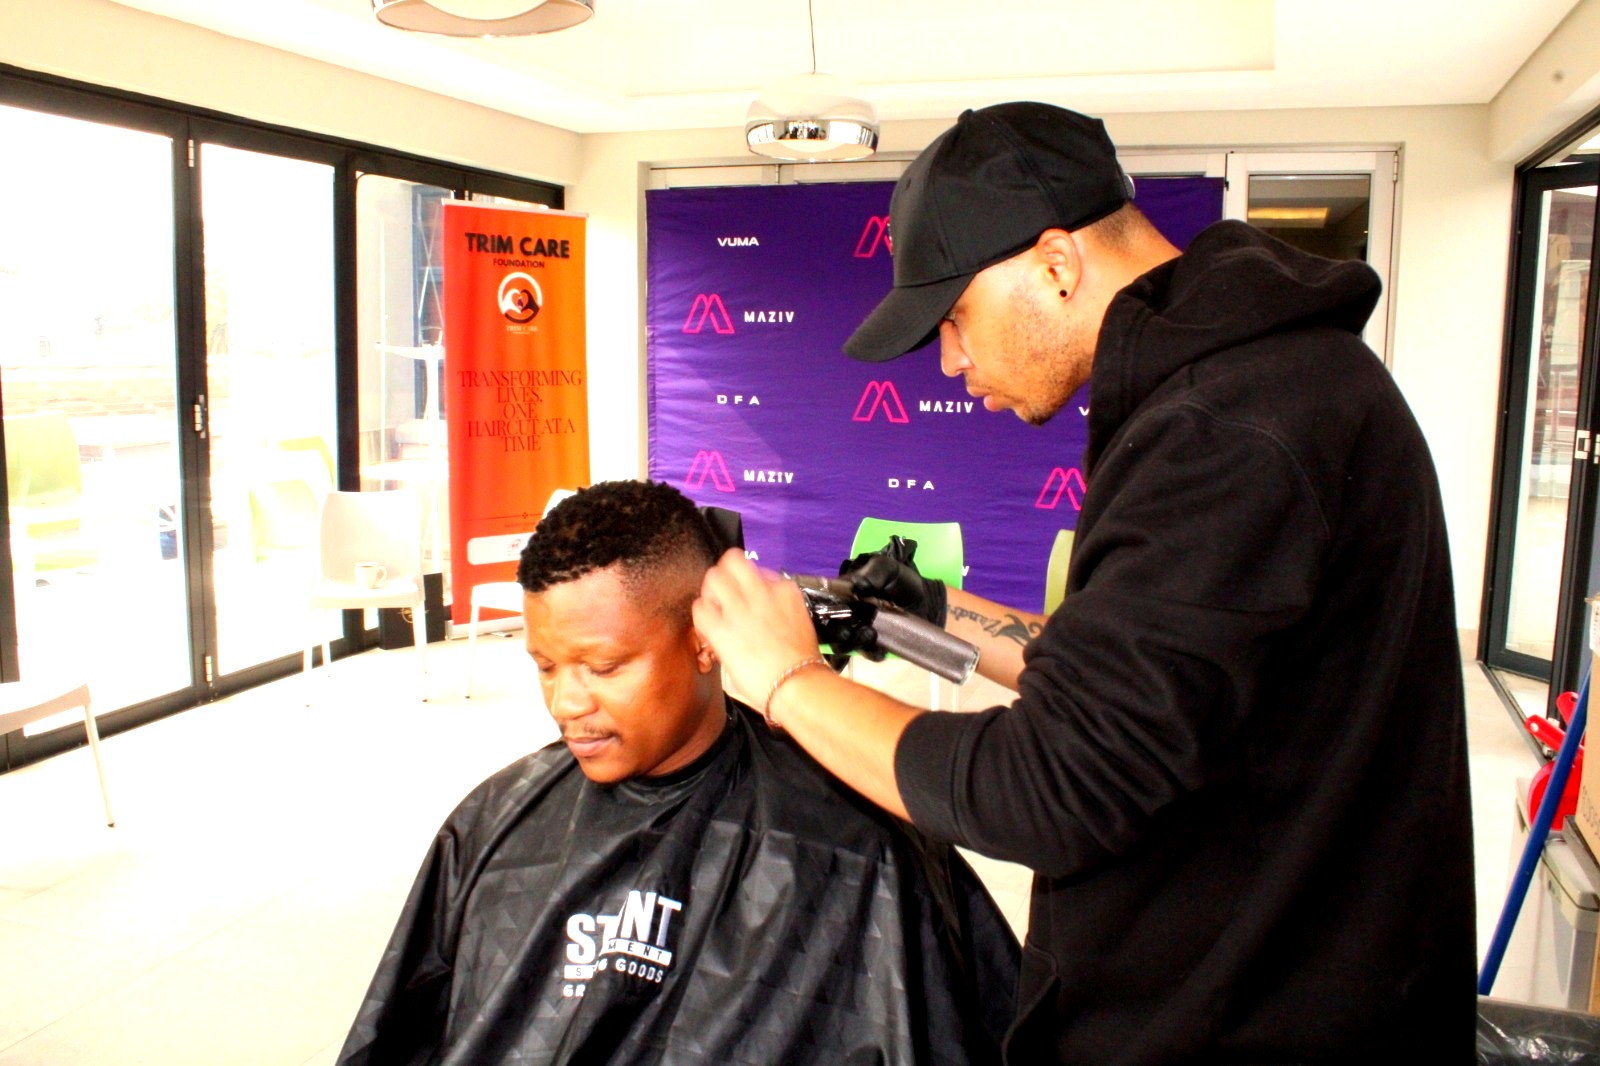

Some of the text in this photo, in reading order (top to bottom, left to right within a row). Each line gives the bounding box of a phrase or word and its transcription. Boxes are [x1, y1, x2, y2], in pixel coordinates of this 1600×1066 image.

[465, 232, 570, 259] TRIM CARE
[717, 236, 760, 247] VUMA
[493, 258, 545, 268] FOUNDATION
[744, 310, 795, 323] MAZIV
[457, 370, 582, 388] TRANSFORMING
[497, 386, 543, 403] LIVES,
[503, 402, 537, 419] ONE
[919, 400, 974, 413] MAZIV
[467, 418, 575, 437] HAIRCUT AT A
[500, 434, 541, 452] TIME
[743, 469, 794, 484] MAZIV
[946, 603, 1002, 638] Zandr
[566, 890, 682, 964] STNT
[615, 957, 664, 983] GOODS
